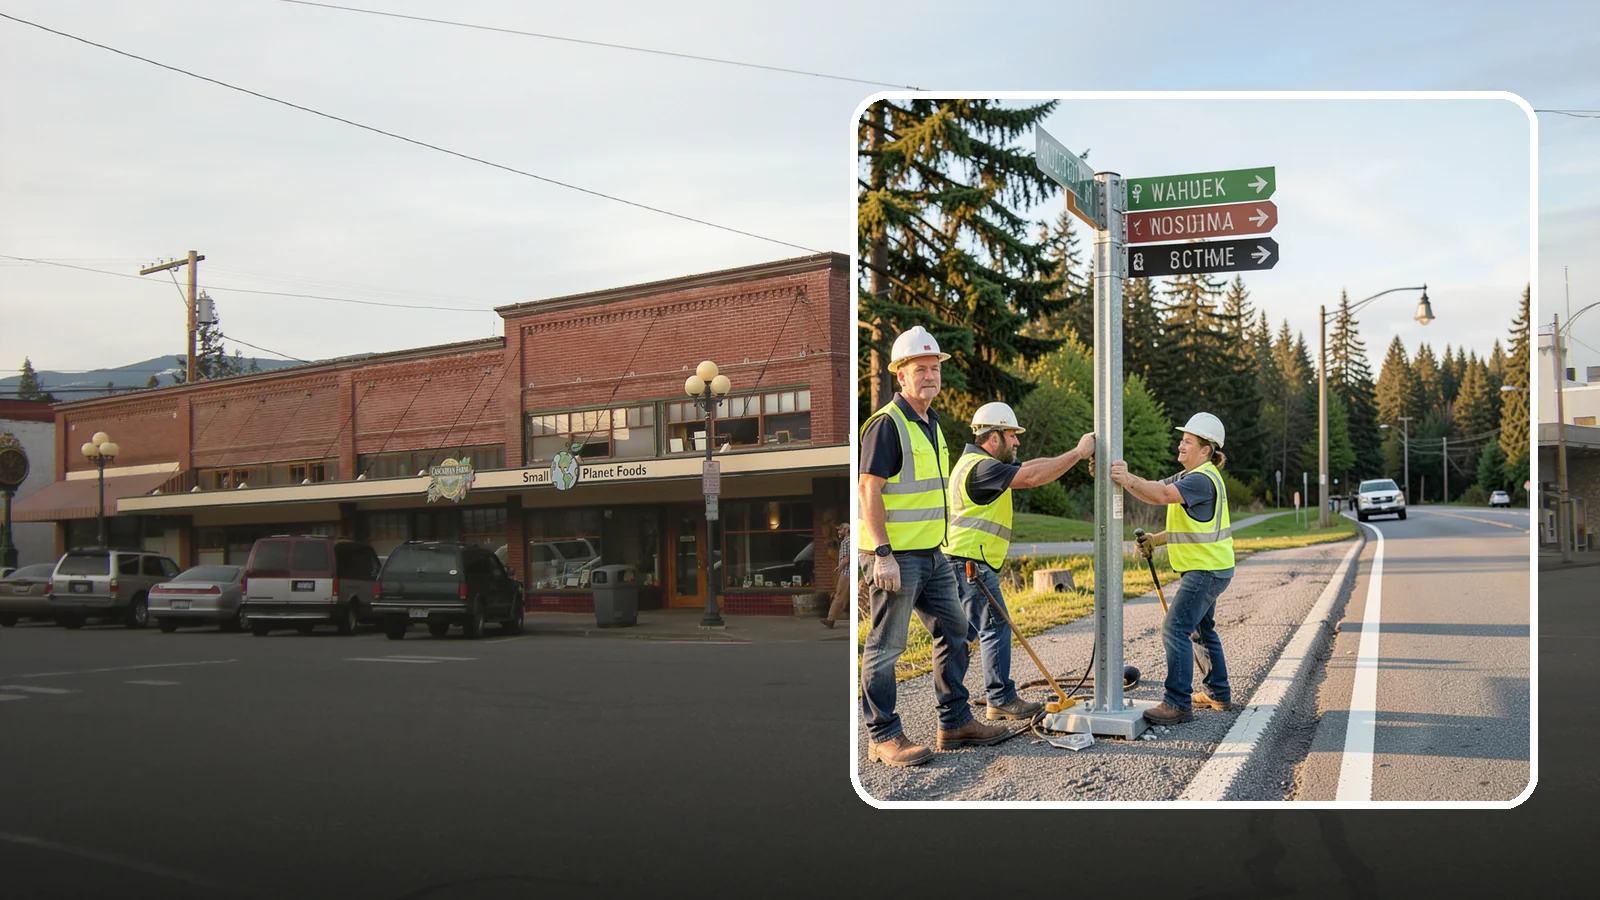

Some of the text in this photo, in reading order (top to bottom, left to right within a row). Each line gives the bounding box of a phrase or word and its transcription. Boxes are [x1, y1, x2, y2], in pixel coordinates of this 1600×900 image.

[523, 464, 647, 483] Small Planet Foods
